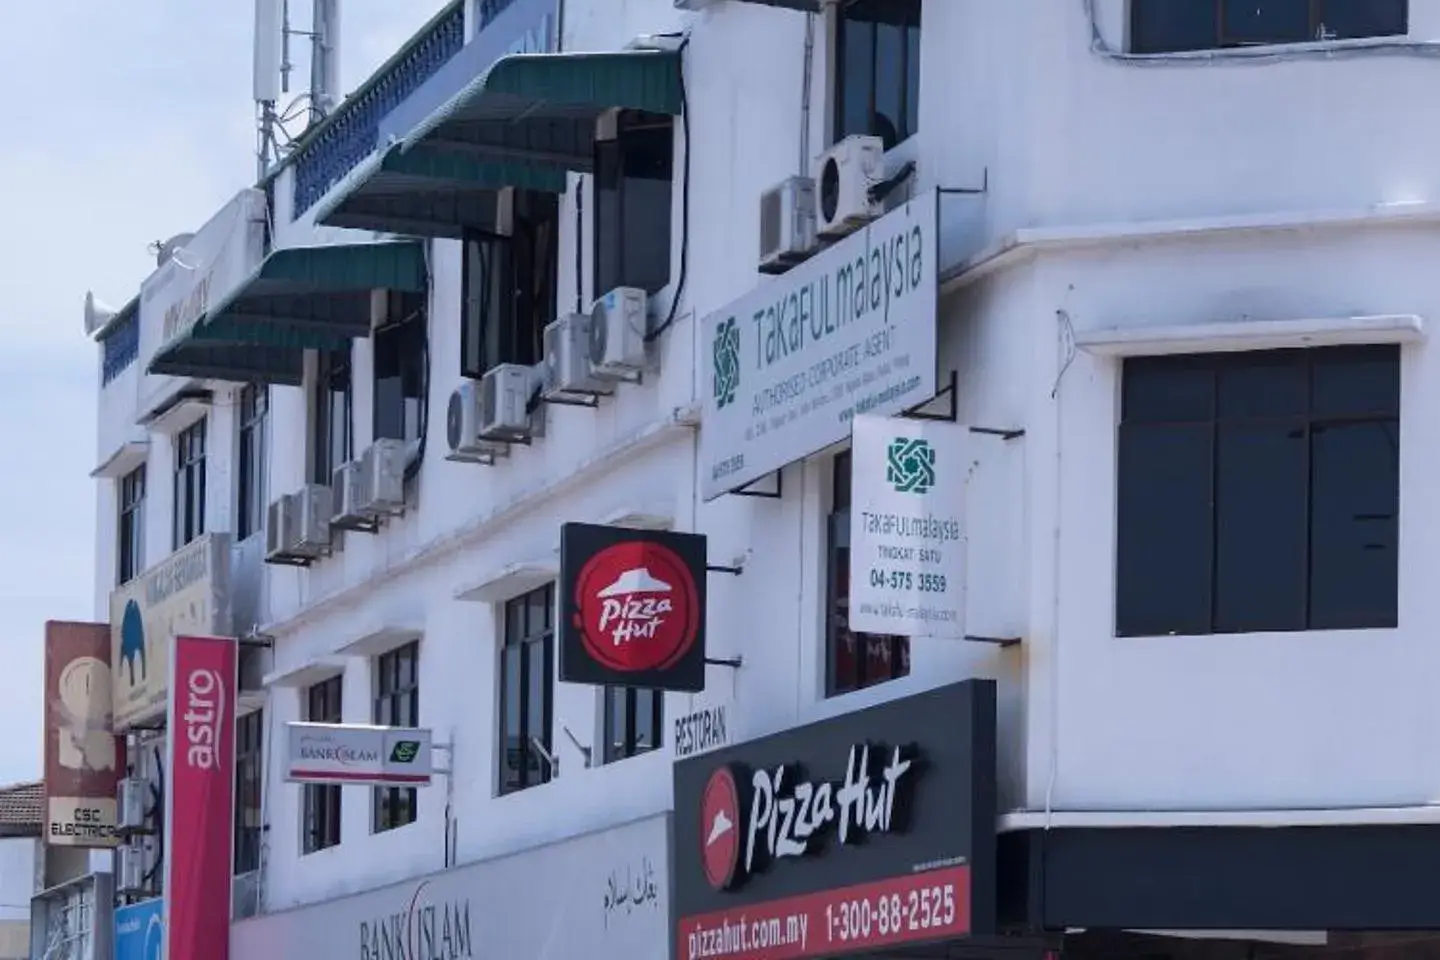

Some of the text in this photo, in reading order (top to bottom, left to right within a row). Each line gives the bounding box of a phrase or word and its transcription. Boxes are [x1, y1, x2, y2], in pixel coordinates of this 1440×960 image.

[599, 593, 673, 632] Pizza
[612, 619, 664, 646] Hut
[184, 670, 215, 770] astro
[675, 705, 727, 757] RESTORAN
[300, 746, 336, 761] BANK
[74, 807, 101, 823] CSC
[744, 743, 912, 874] Pizza Hut
[360, 897, 472, 960] BANK ISLAM
[688, 883, 955, 958] pizzahut.com.my 1-300-88-2525
